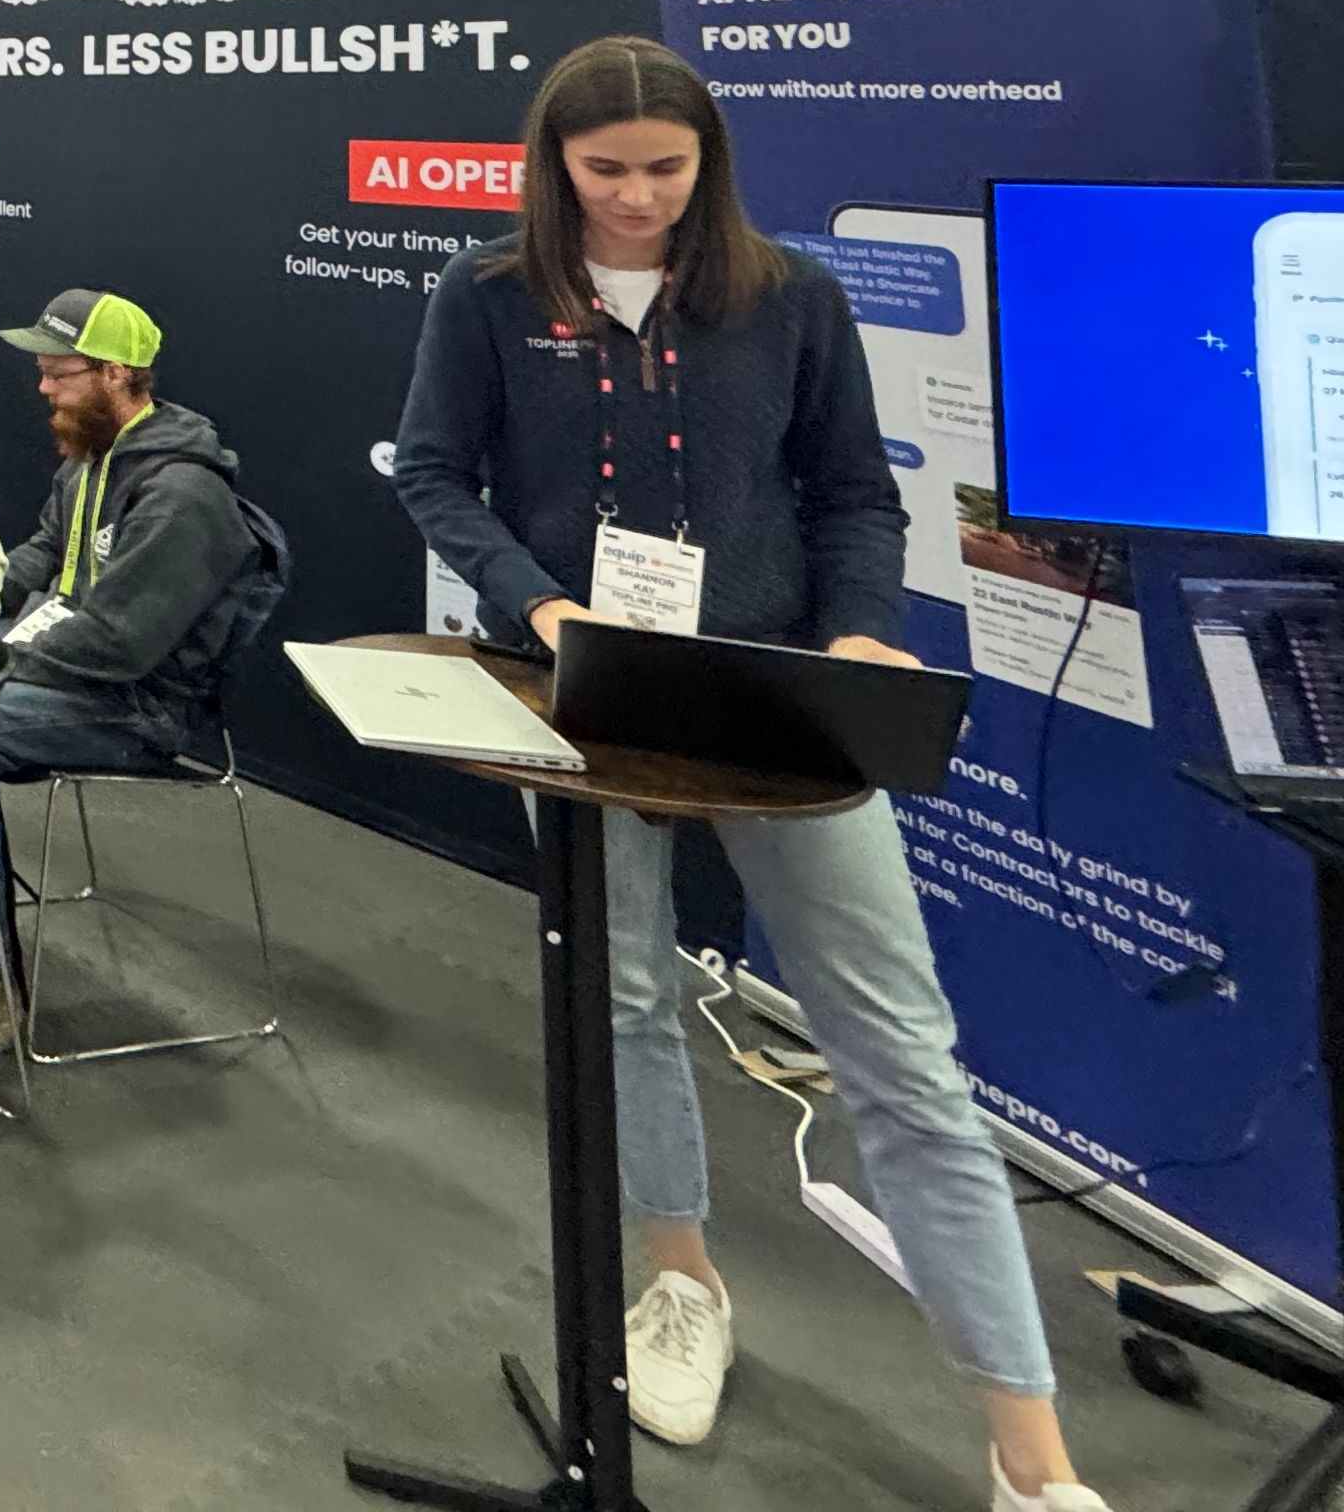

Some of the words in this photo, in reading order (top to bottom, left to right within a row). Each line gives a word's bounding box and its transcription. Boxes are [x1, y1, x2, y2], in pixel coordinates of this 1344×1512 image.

[701, 25, 770, 51] FOR
[772, 22, 852, 49] YOU
[83, 30, 193, 76] LESS
[707, 80, 766, 98] Grow
[769, 78, 856, 100] without
[860, 83, 925, 100] more
[930, 80, 1063, 101] overhead
[366, 156, 408, 189] AI
[300, 223, 340, 246] Get
[345, 230, 396, 252] your
[403, 229, 459, 253] time
[285, 256, 412, 290] follow-ups,
[833, 261, 860, 272] East
[923, 253, 945, 266] the
[603, 546, 647, 565] equip
[967, 805, 1007, 838] the
[1012, 825, 1073, 868] daly
[1078, 855, 1150, 897] grind
[1156, 883, 1191, 917] by
[914, 847, 938, 868] at
[941, 858, 958, 876] a
[962, 864, 1055, 919] fraction
[1092, 921, 1136, 955] the
[918, 813, 948, 842] for
[1104, 896, 1132, 921] to
[1136, 909, 1225, 962] tackle
